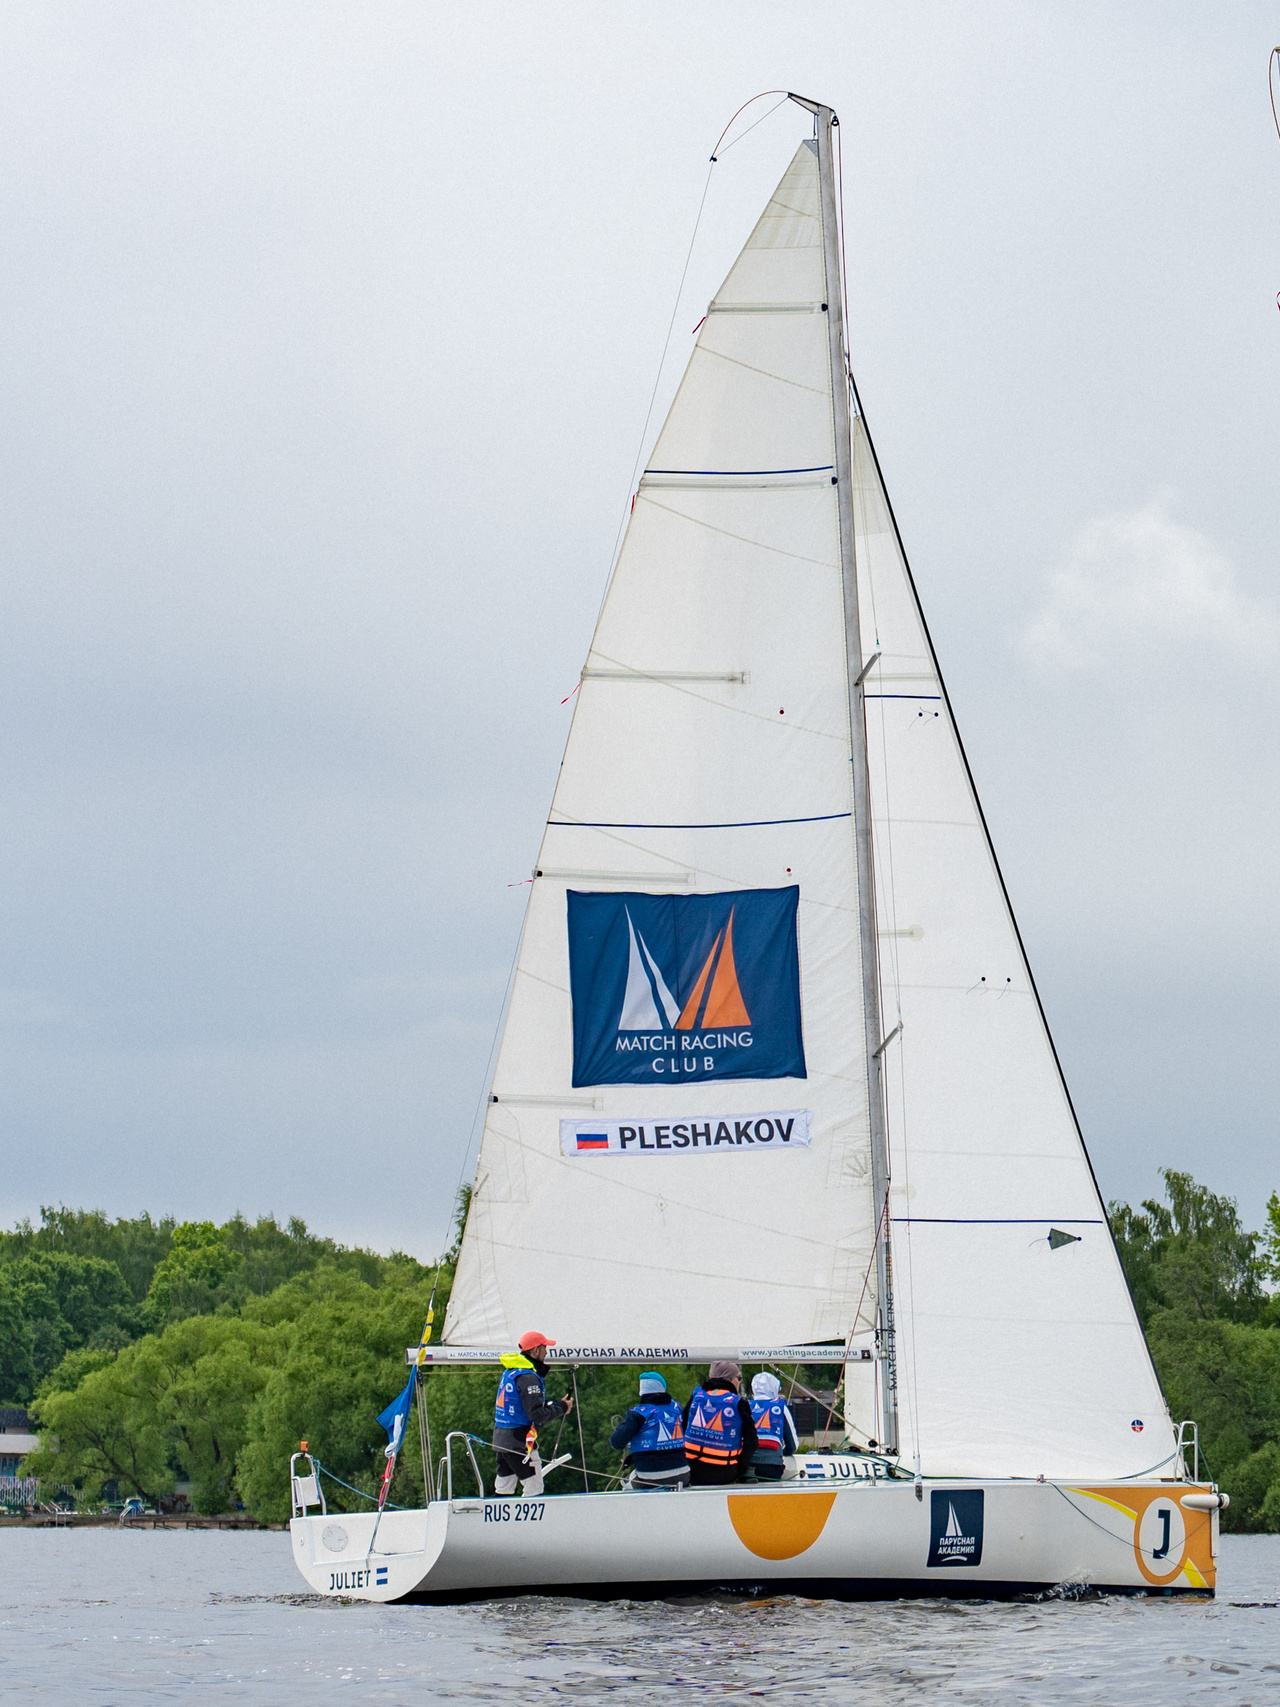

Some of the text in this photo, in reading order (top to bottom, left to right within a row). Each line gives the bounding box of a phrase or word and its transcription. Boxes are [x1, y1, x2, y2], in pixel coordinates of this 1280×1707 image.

[615, 1031, 753, 1051] MATCH RACING
[652, 1056, 714, 1073] CLUB
[618, 1118, 795, 1149] PLESHAKOV
[549, 1348, 688, 1358] ПАРУСНАЯ АКАДЕМИЯ
[829, 1463, 887, 1479] JULIE
[484, 1503, 545, 1522] RUS 2927
[939, 1537, 975, 1546] ПАРУСНАЯ
[1152, 1509, 1171, 1559] J
[937, 1545, 975, 1555] АКАДЕМИЯ
[329, 1570, 371, 1590] JULIET
